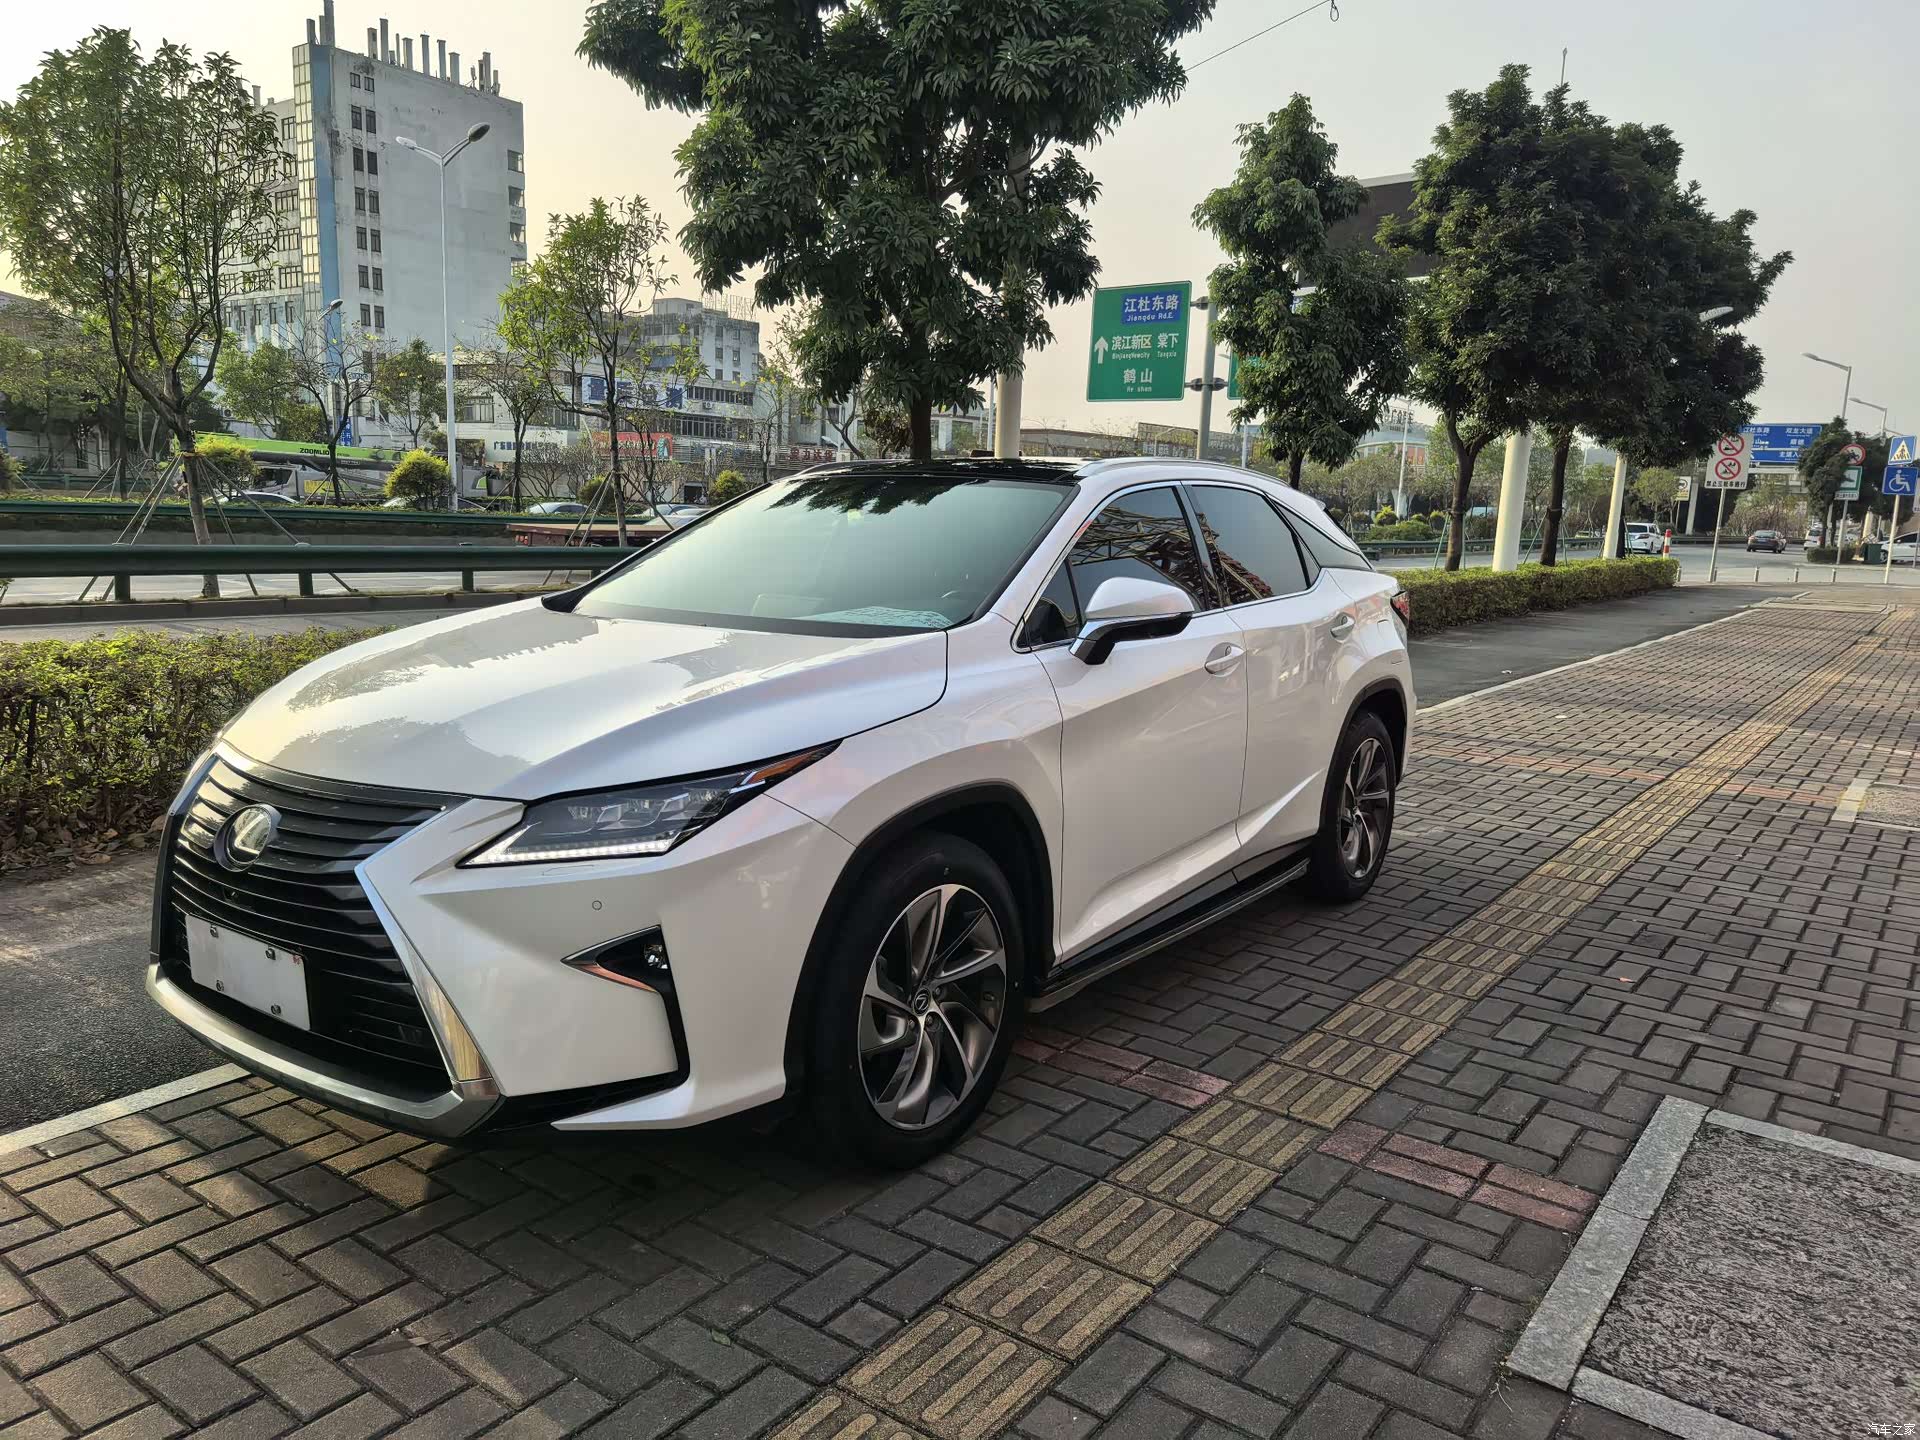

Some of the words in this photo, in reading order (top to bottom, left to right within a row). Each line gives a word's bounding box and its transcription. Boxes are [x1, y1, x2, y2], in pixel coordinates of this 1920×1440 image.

[1124, 294, 1179, 312] 江杜东路
[1111, 335, 1152, 350] 滨江新区
[1157, 333, 1179, 348] 棠下
[300, 447, 330, 456] ZOOMLIO
